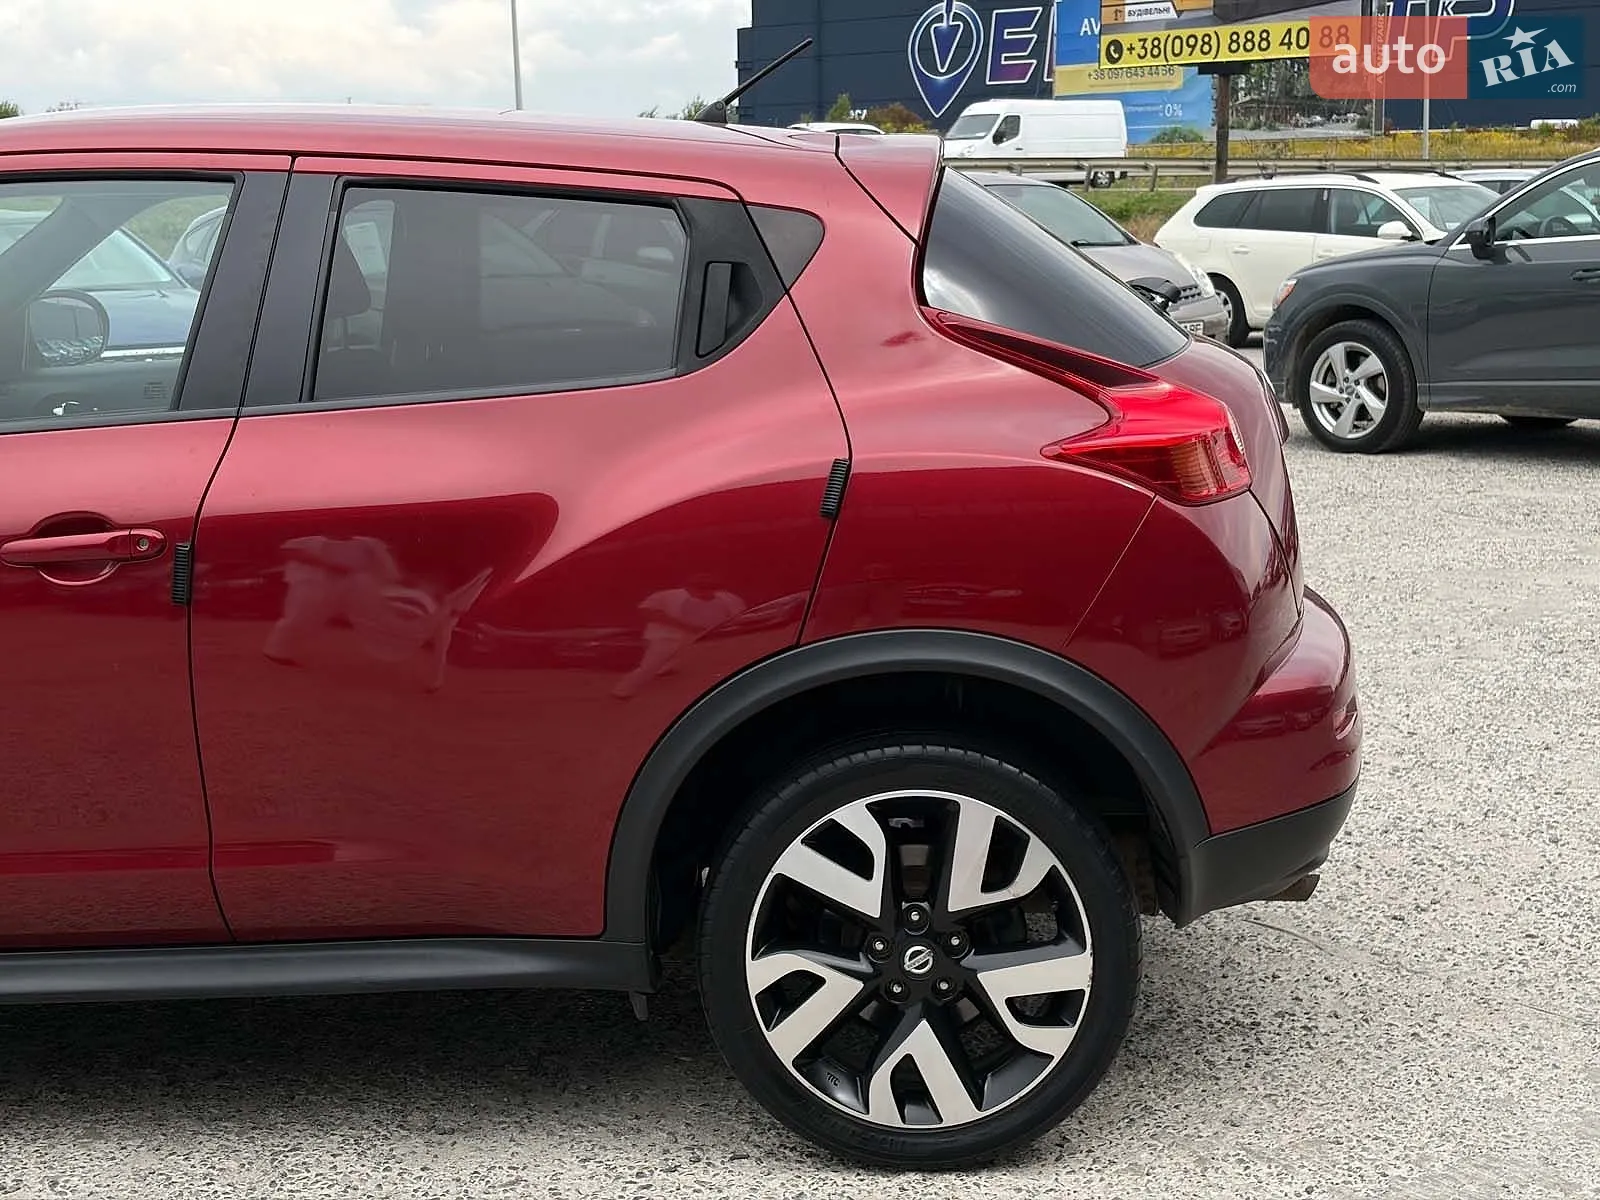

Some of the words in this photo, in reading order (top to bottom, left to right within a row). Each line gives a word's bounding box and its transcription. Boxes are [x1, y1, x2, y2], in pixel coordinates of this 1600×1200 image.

[1126, 30, 1221, 64] +38(098)
[1227, 29, 1272, 54] 888
[1278, 26, 1310, 51] 40
